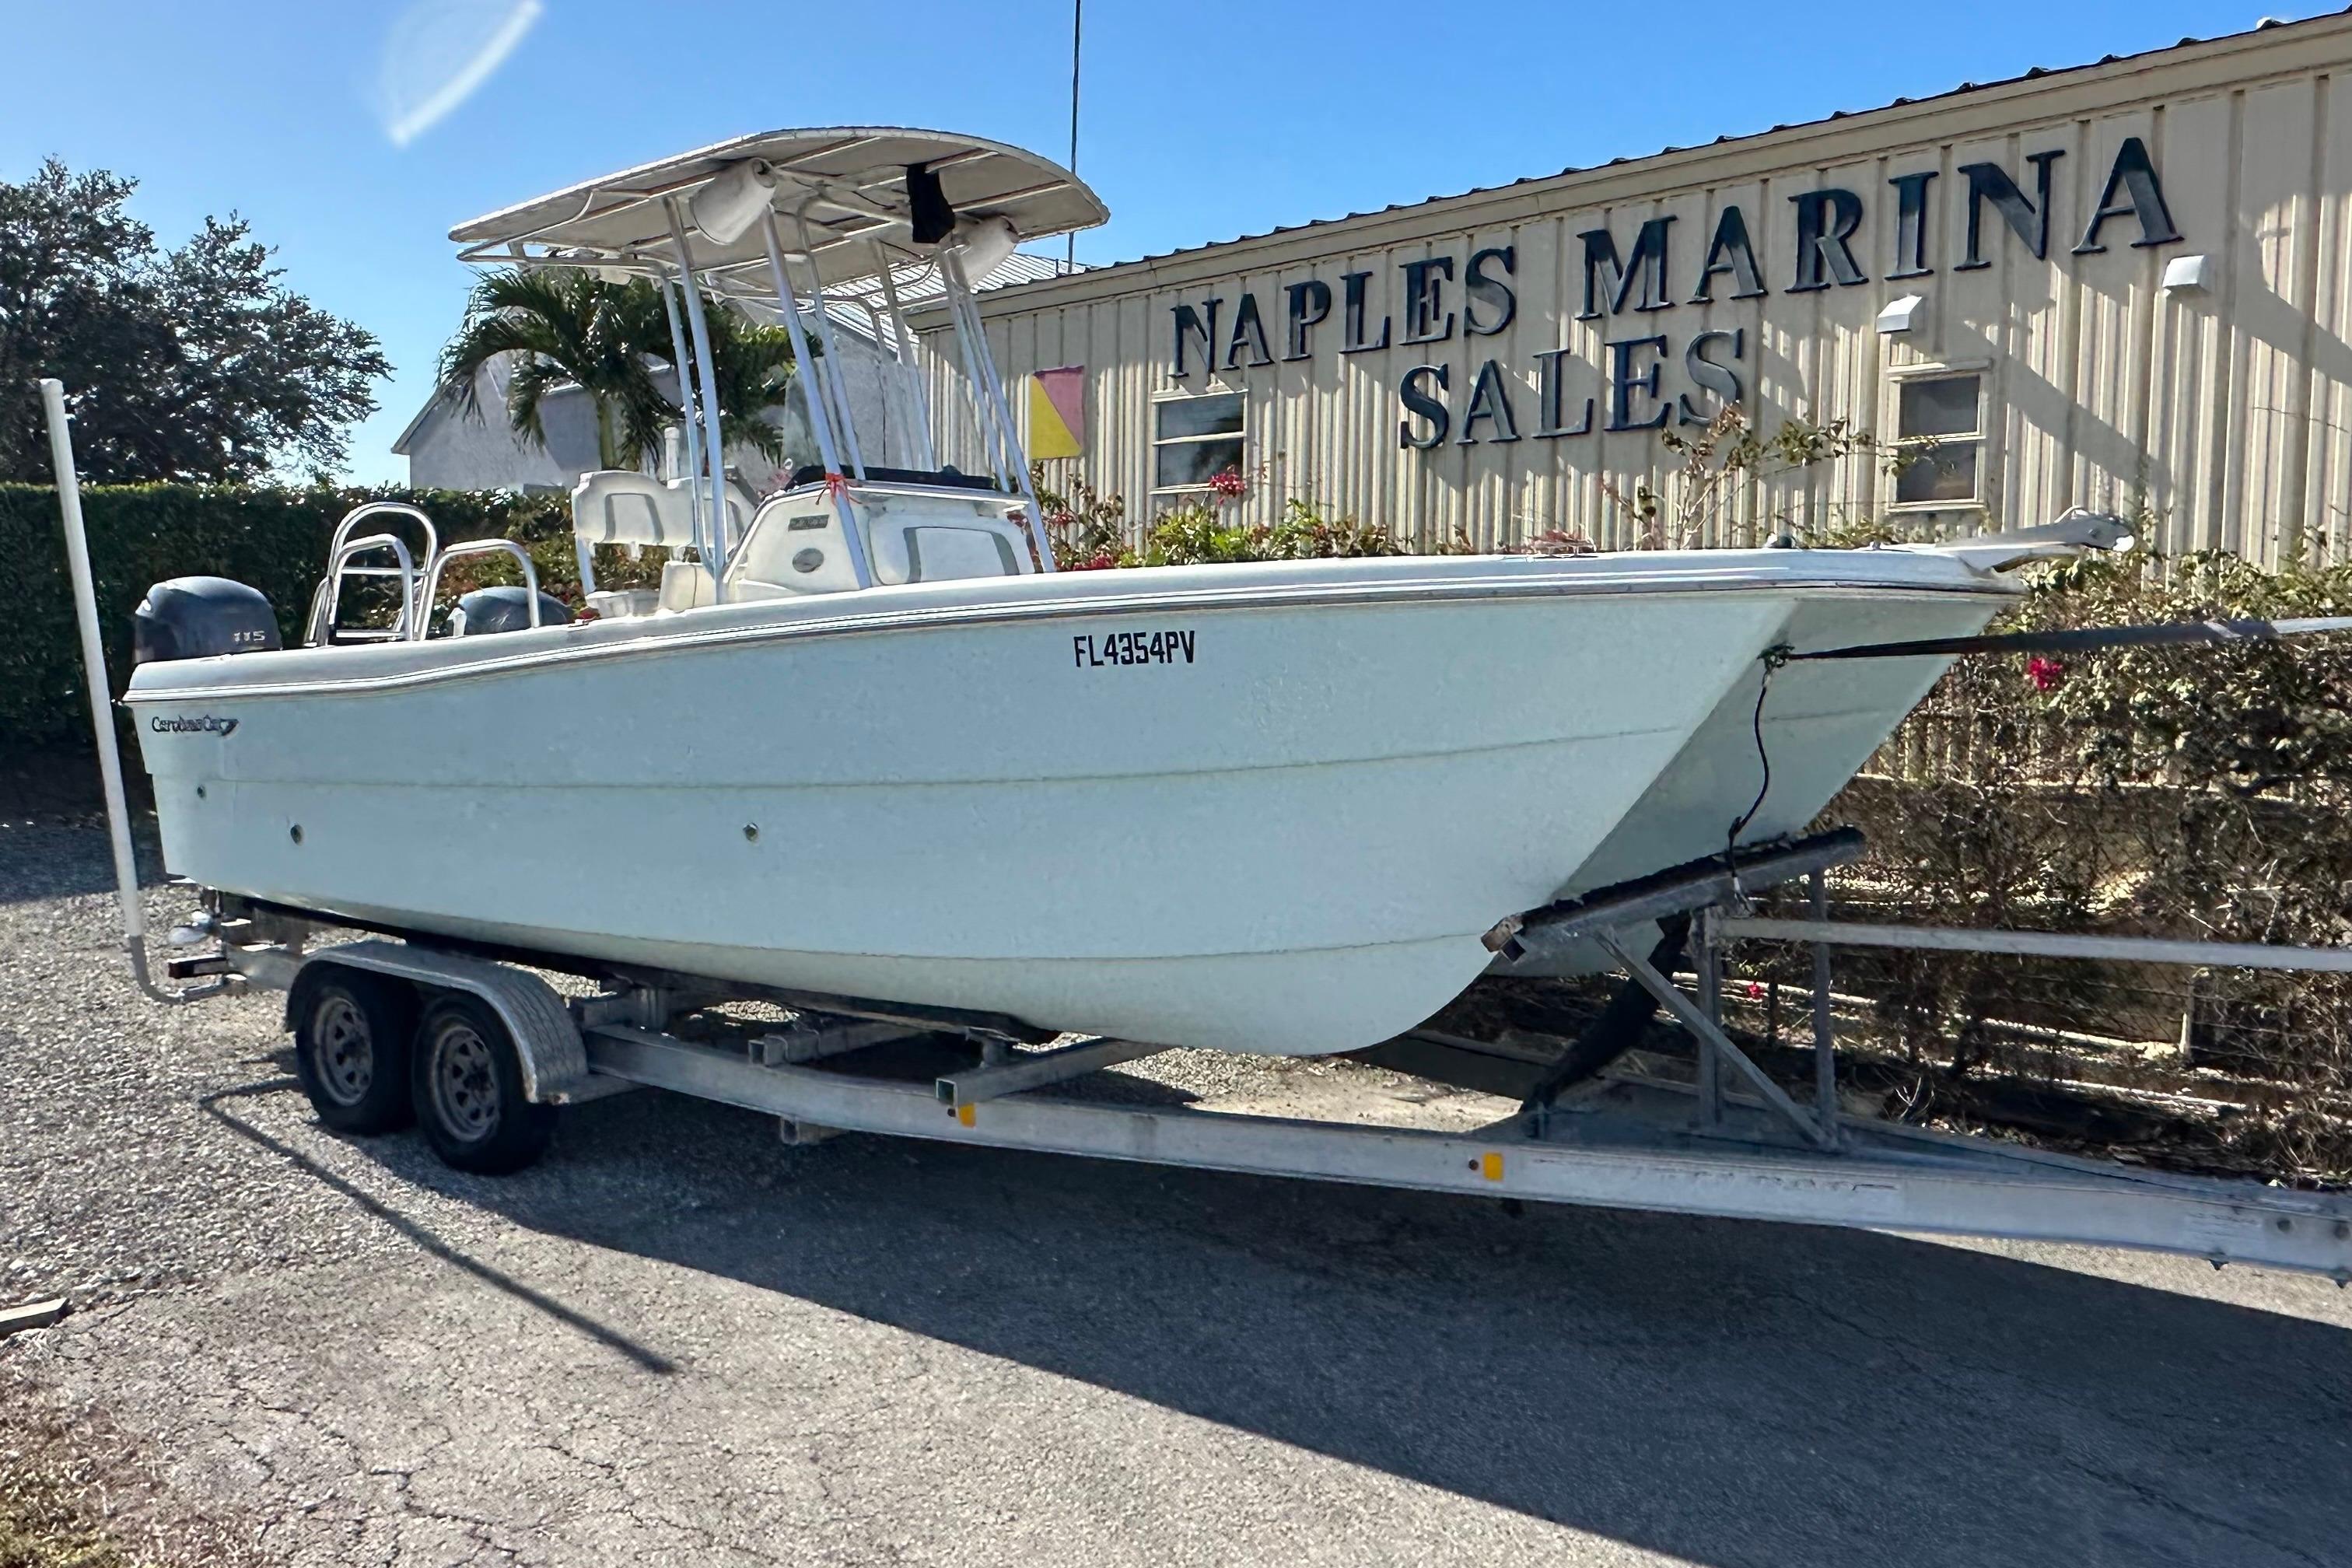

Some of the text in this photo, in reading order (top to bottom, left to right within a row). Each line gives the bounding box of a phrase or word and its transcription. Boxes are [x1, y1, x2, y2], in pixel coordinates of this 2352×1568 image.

[1168, 137, 2185, 378] NAPLES MARINA
[1399, 327, 1744, 450] SALES
[231, 630, 265, 642] 115
[1073, 630, 1195, 667] FL4354PV
